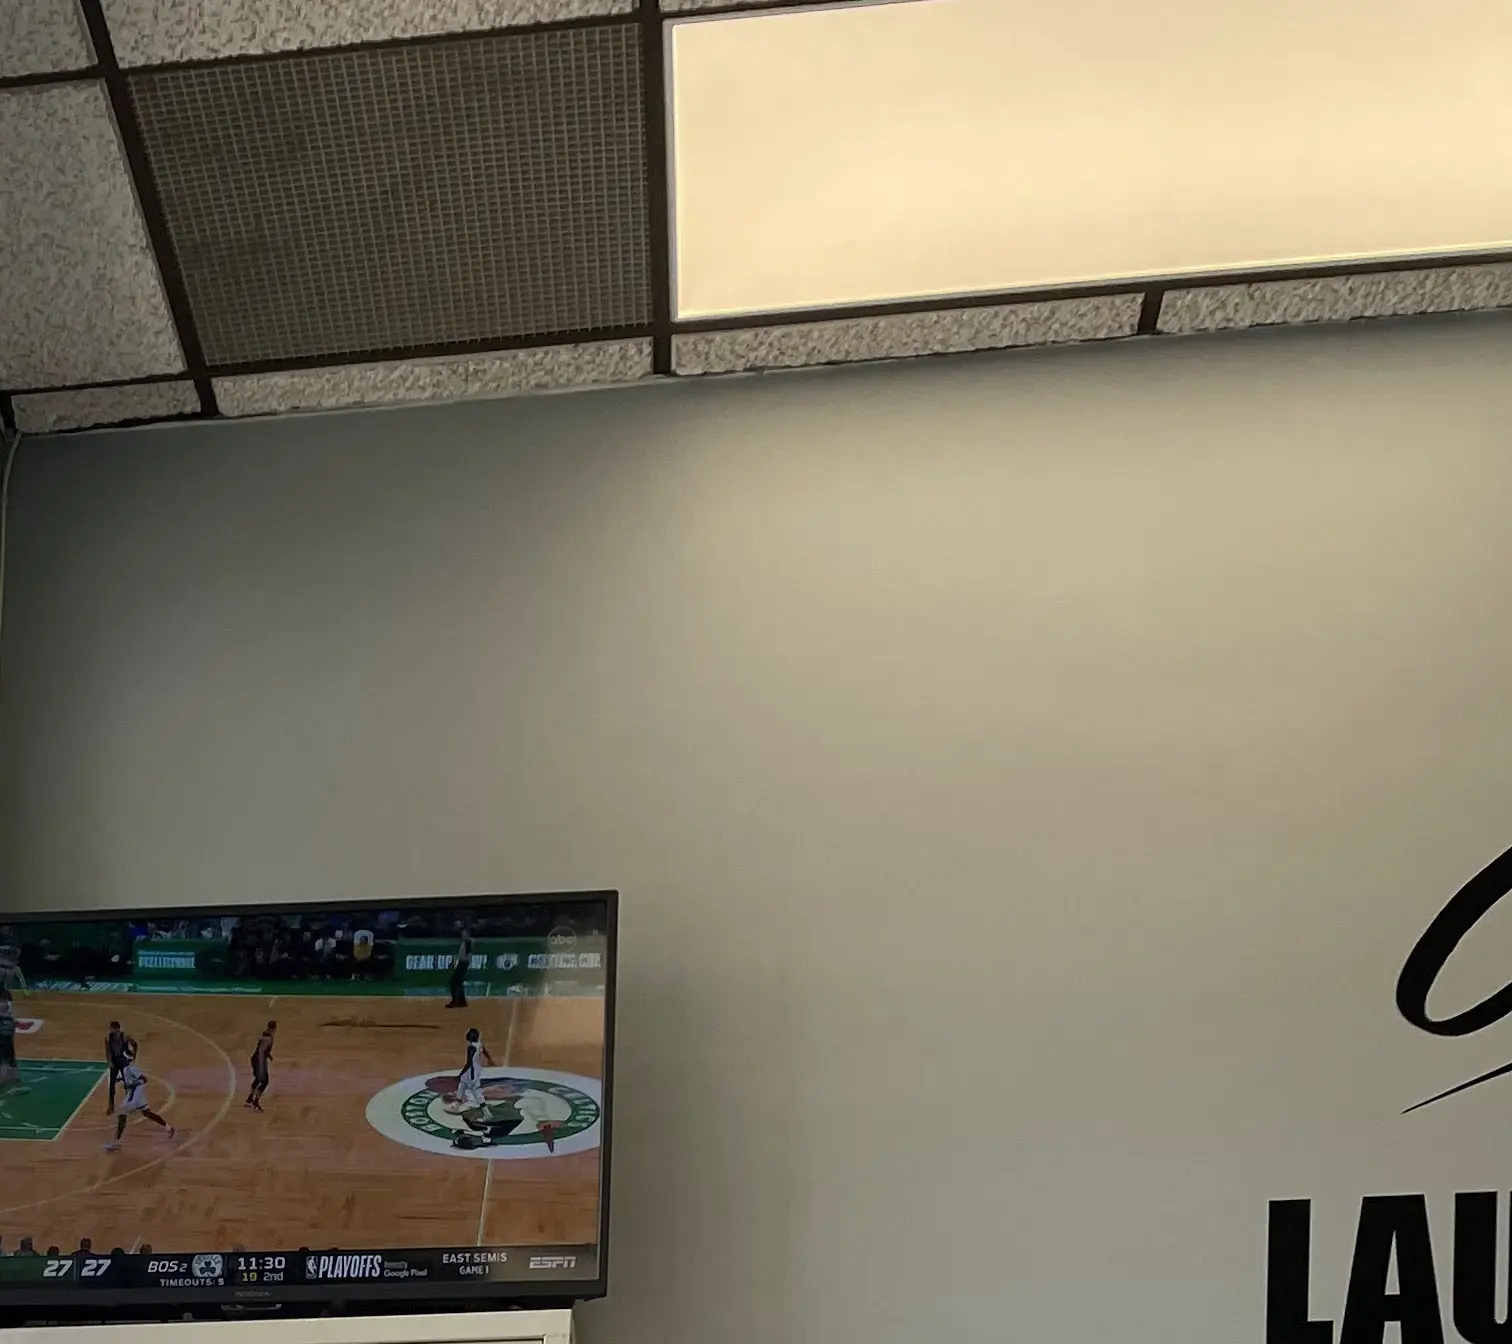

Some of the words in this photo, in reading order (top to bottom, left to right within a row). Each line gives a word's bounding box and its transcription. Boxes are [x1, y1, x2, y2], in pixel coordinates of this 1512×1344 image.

[237, 1256, 286, 1271] 11:30
[442, 1253, 471, 1264] EAST
[474, 1252, 508, 1264] SEMIS
[529, 1256, 576, 1269] ESPN
[43, 1259, 73, 1277] 27
[81, 1259, 112, 1277] 27
[148, 1260, 177, 1274] BOS
[318, 1255, 382, 1279] PLAYOFFS
